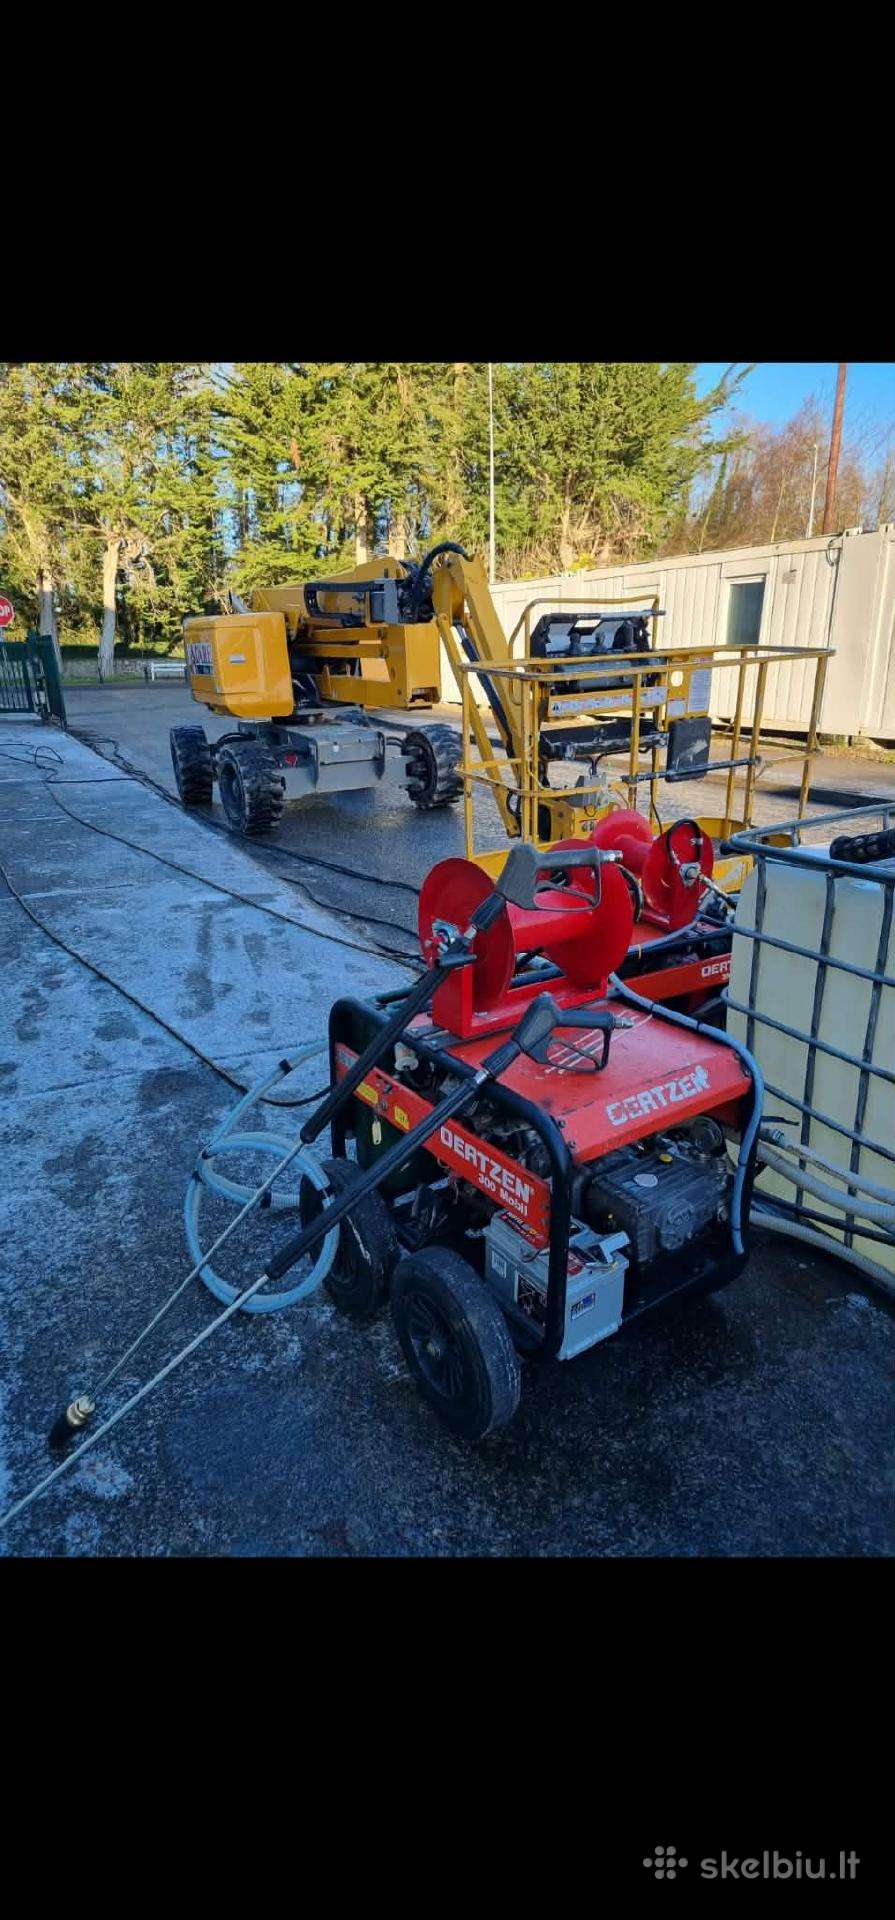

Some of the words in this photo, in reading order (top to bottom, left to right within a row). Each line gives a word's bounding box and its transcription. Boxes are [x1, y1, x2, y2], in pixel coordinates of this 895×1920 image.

[441, 1126, 530, 1203] OERTZEN
[479, 1173, 496, 1191] 300
[500, 1188, 528, 1216] Mobil
